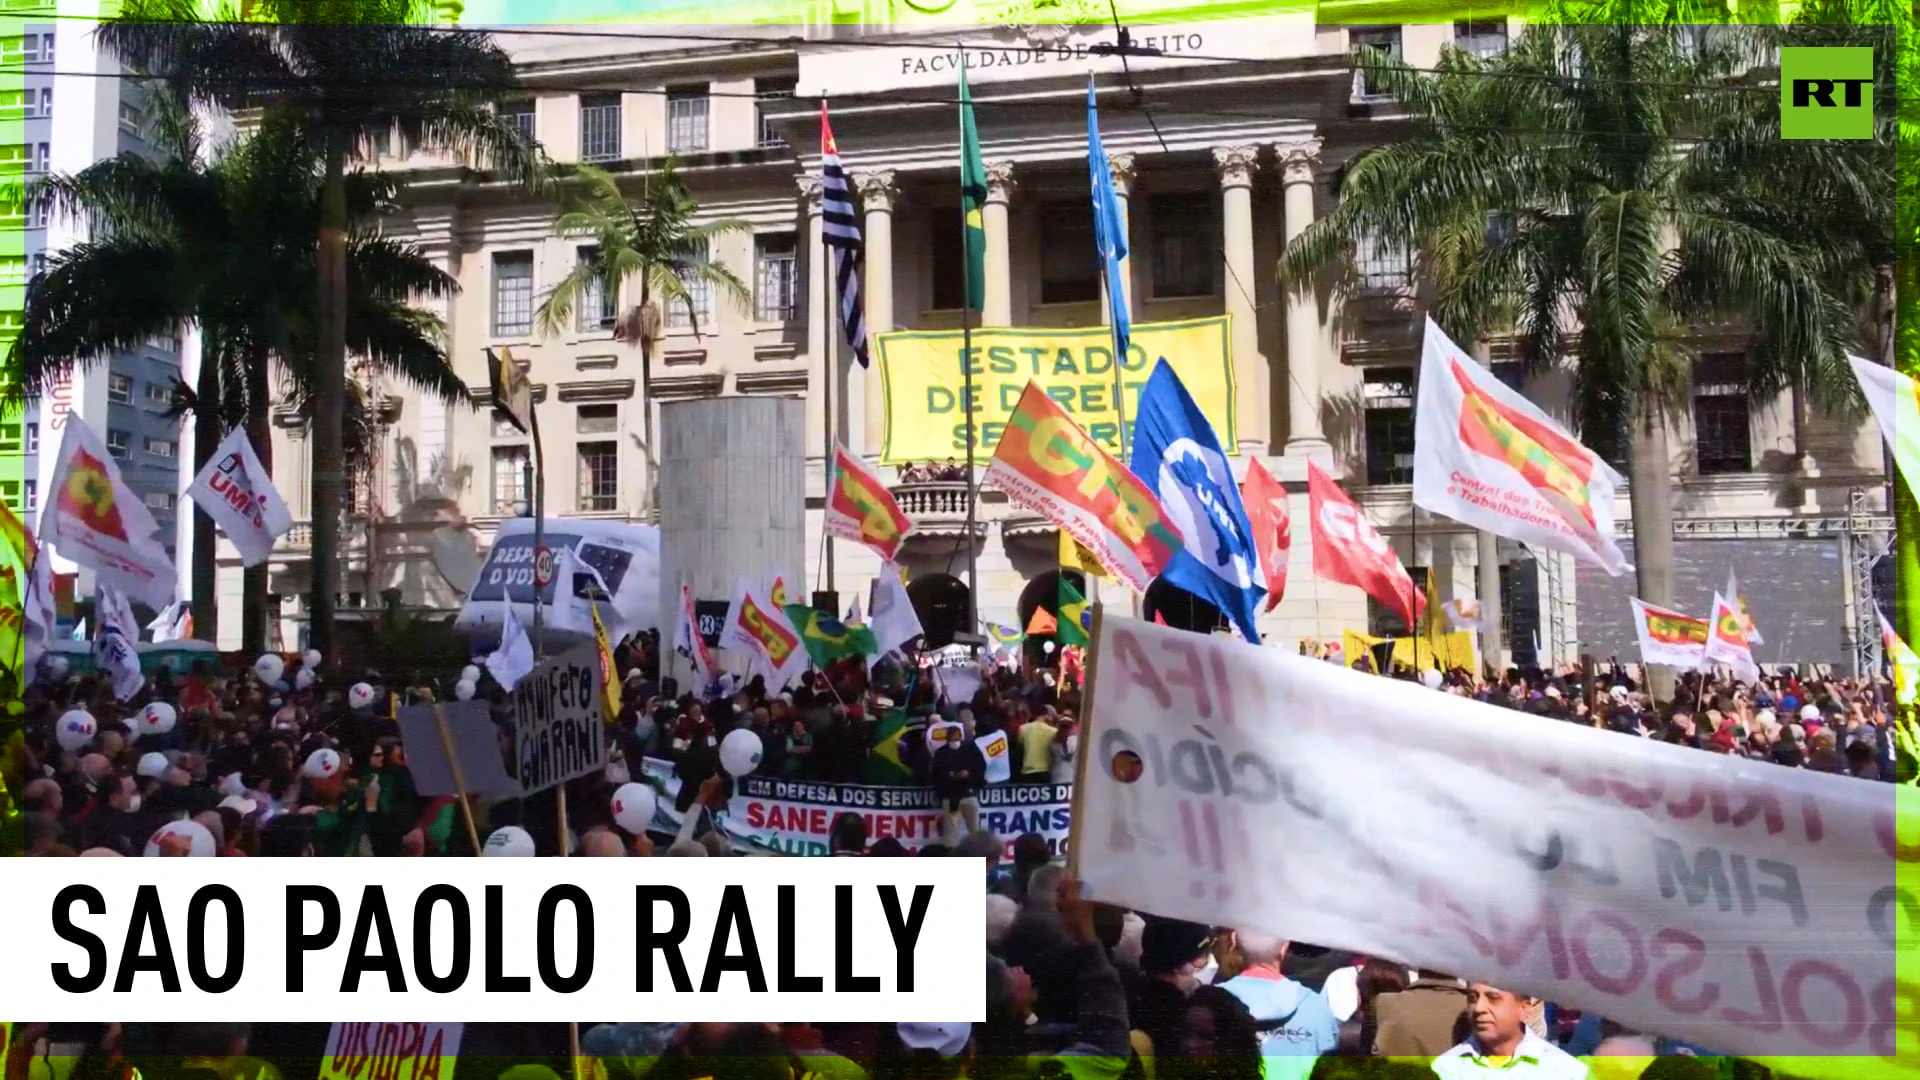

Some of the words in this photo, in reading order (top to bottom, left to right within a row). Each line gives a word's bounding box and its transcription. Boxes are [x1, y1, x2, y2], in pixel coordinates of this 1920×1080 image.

[1056, 42, 1089, 62] DE
[1098, 32, 1203, 56] DREITO
[957, 344, 1148, 375] ESTADO
[926, 384, 982, 413] DE
[999, 382, 1145, 413] DREIT
[747, 779, 771, 796] EM
[775, 781, 838, 803] DEFESA
[842, 787, 876, 805] DOS
[979, 786, 1050, 804] UBLICOS
